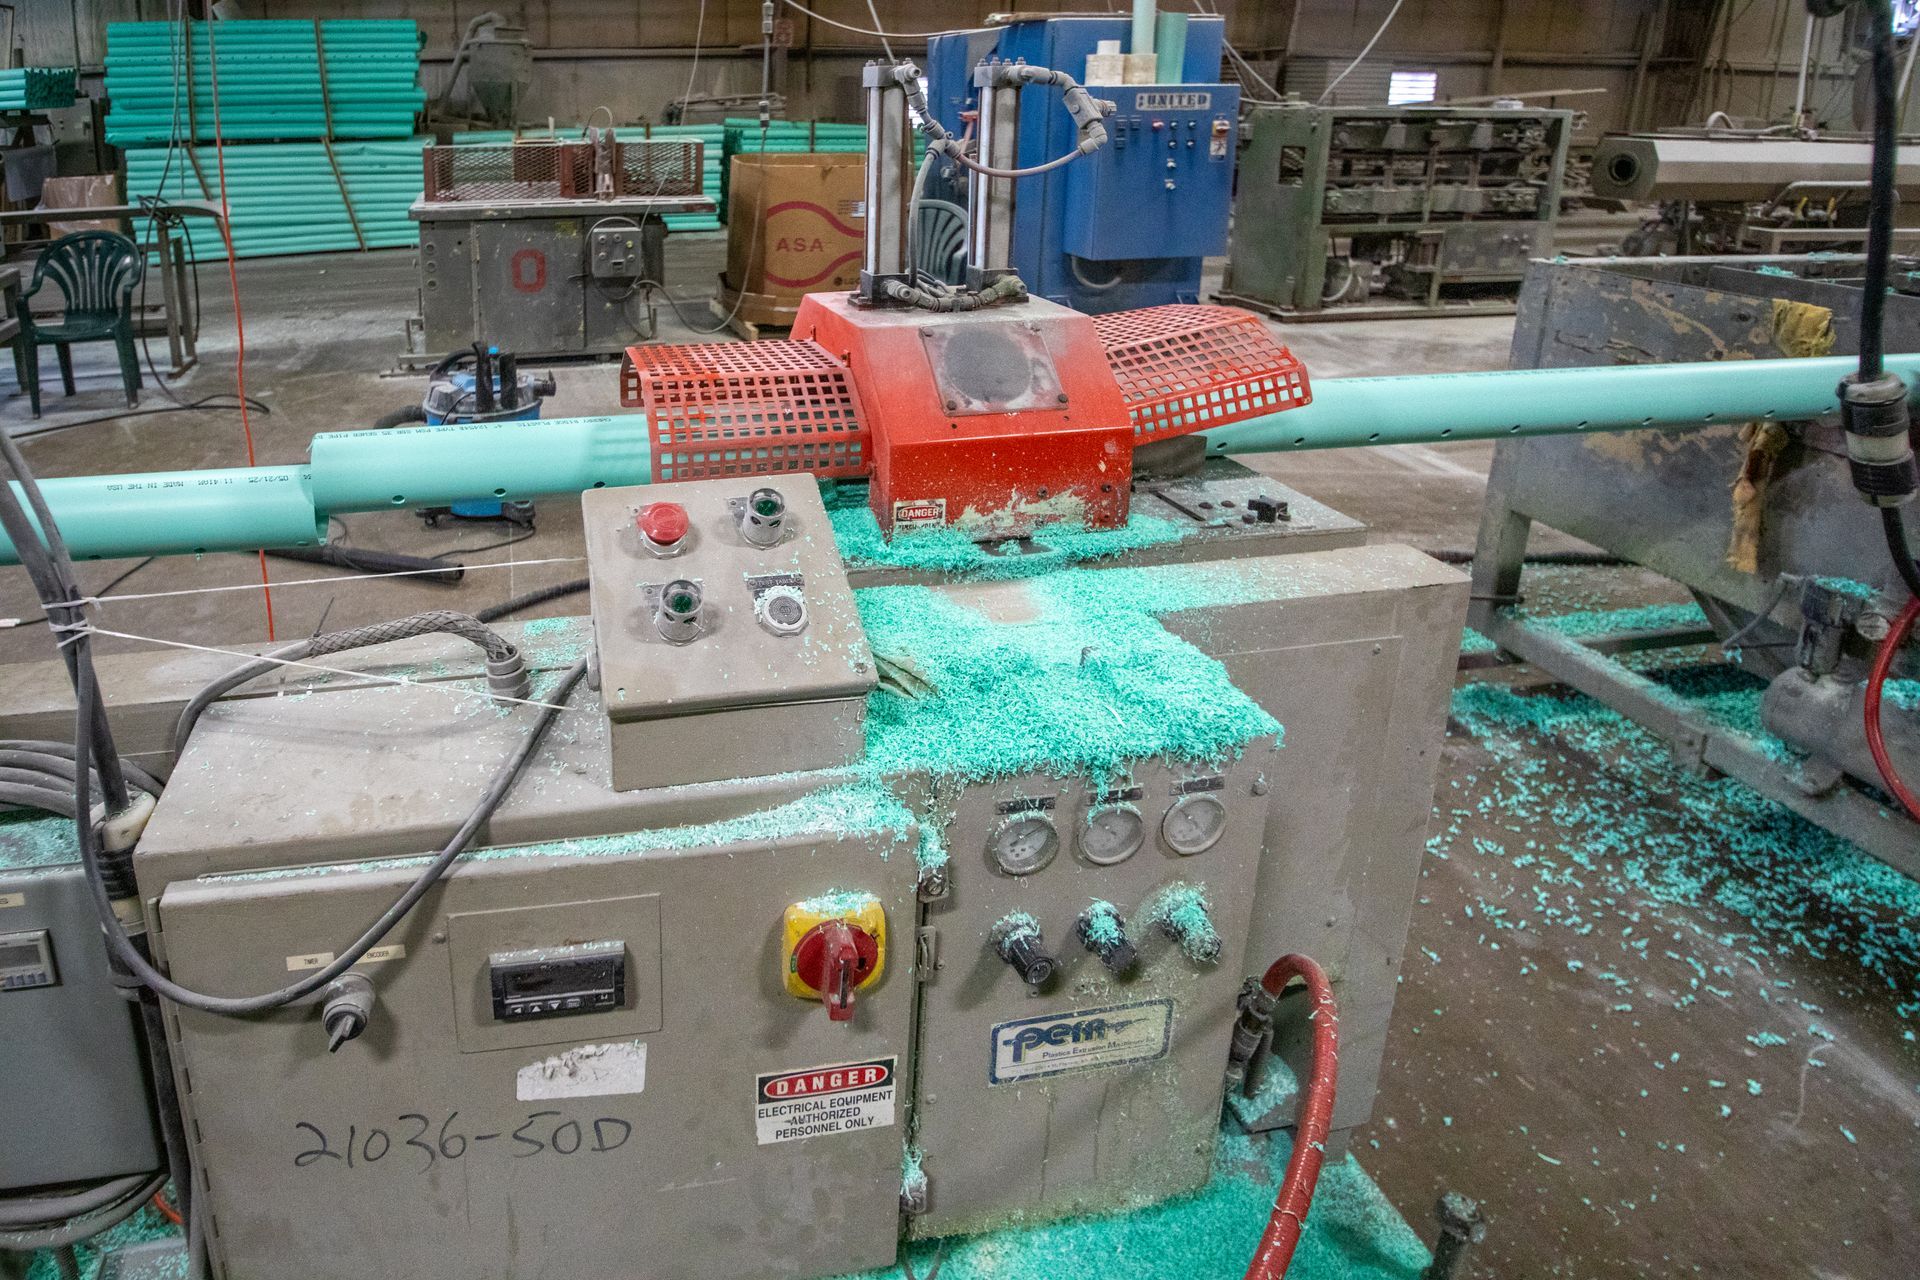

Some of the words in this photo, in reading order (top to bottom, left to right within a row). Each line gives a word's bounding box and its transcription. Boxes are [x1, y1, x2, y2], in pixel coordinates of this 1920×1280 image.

[1147, 94, 1207, 105] UNITED
[776, 238, 823, 252] ASA
[901, 508, 939, 517] DANGER
[367, 950, 390, 959] ENCODER
[1042, 1050, 1071, 1059] Plastics
[1072, 1044, 1106, 1054] Extrusion
[776, 1069, 877, 1095] DANGER
[758, 1100, 827, 1119] ELECTRICAL
[830, 1090, 893, 1108] EQUIPMENT
[790, 1107, 861, 1125] AUTHORIZED
[775, 1121, 842, 1139] PERSONNEL
[845, 1116, 874, 1129] ONLY
[294, 1111, 632, 1175] 21036-50D
